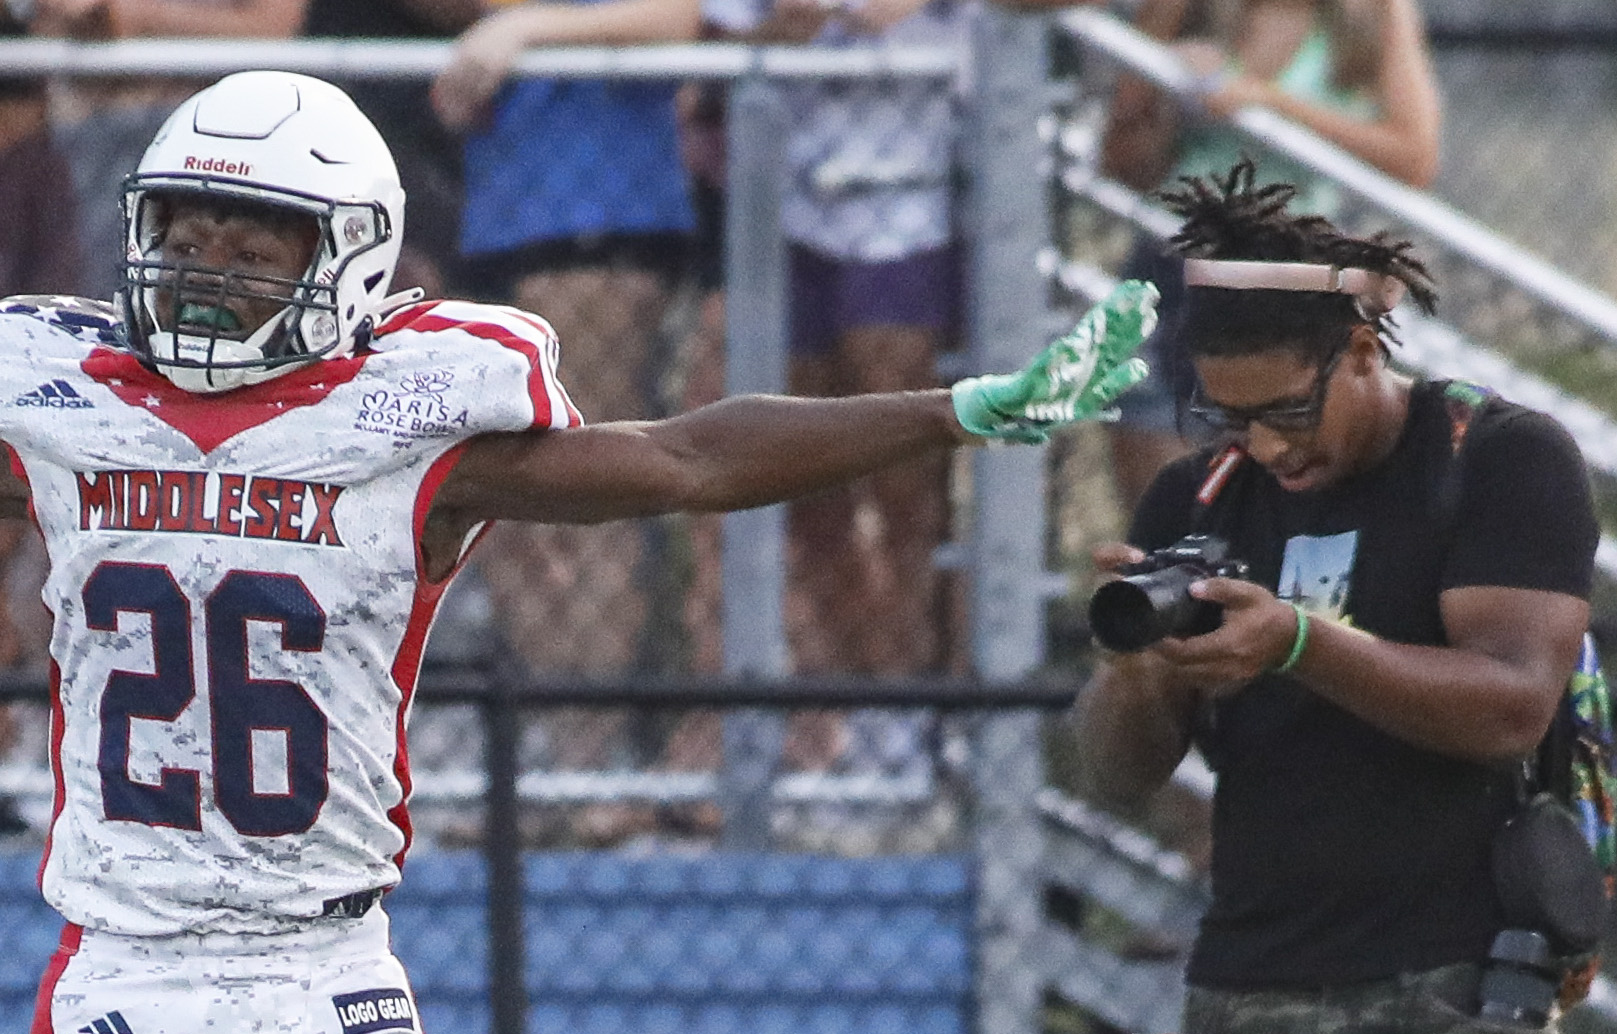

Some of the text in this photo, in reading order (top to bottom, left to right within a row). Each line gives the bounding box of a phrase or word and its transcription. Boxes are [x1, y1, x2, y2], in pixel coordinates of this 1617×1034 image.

[184, 155, 251, 176] Riddell
[15, 395, 96, 409] adidas
[362, 389, 469, 427] MARISA
[356, 409, 407, 428] ROSE
[75, 469, 348, 549] MIDDLESEX
[81, 560, 329, 838] 26
[338, 997, 413, 1028] LOGO GEAR
